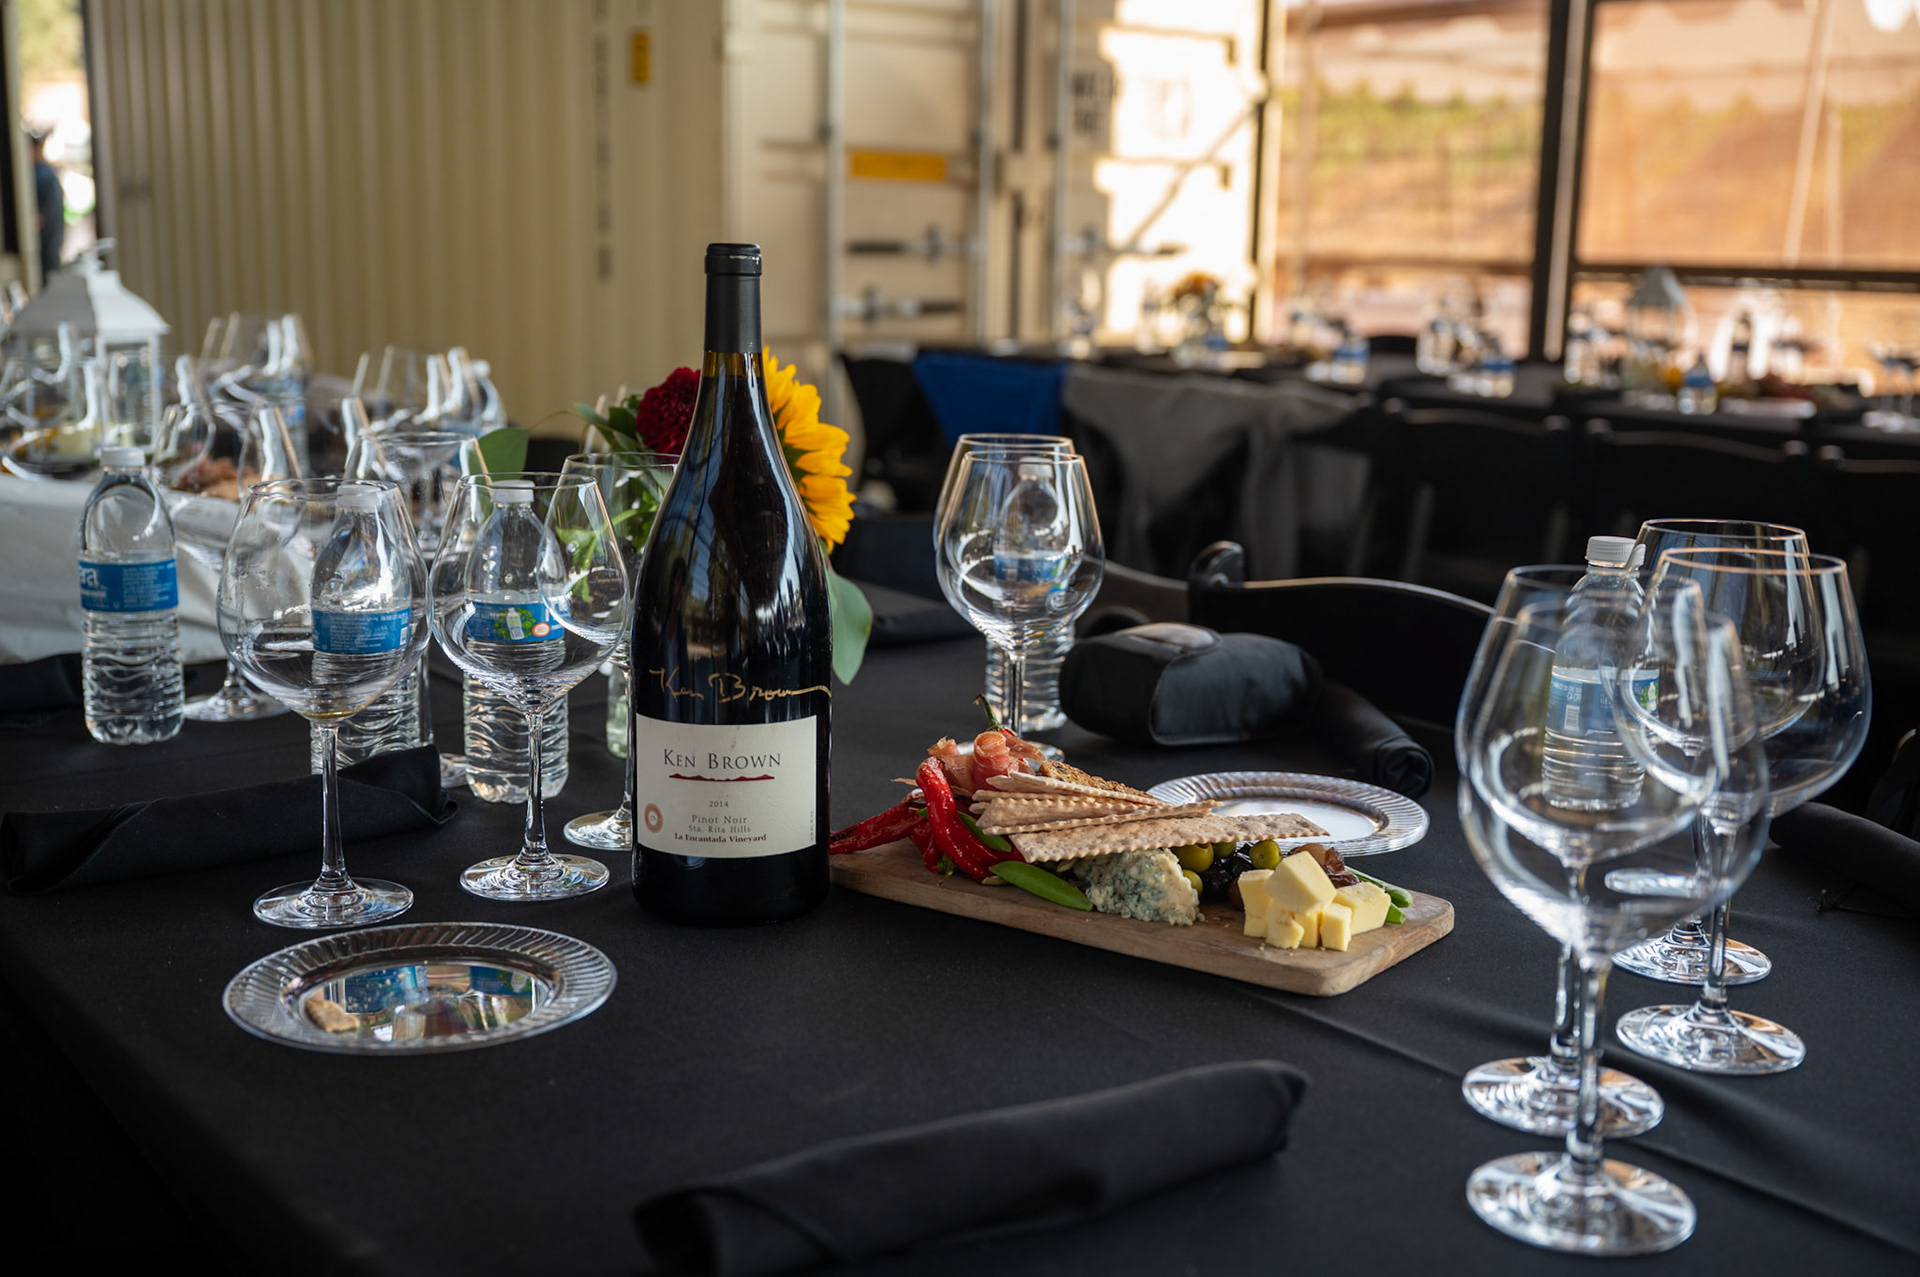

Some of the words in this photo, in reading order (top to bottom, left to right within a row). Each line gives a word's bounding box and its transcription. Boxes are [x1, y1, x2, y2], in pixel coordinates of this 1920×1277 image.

[663, 748, 696, 768] KEN
[708, 752, 781, 770] BROWN
[709, 800, 729, 808] 2014
[692, 814, 719, 824] Pinot
[724, 815, 748, 824] Noir
[708, 824, 726, 834] Rita
[730, 824, 751, 833] Hills
[674, 832, 683, 841] La
[685, 834, 727, 843] Encantada
[729, 833, 767, 844] Vineyard
